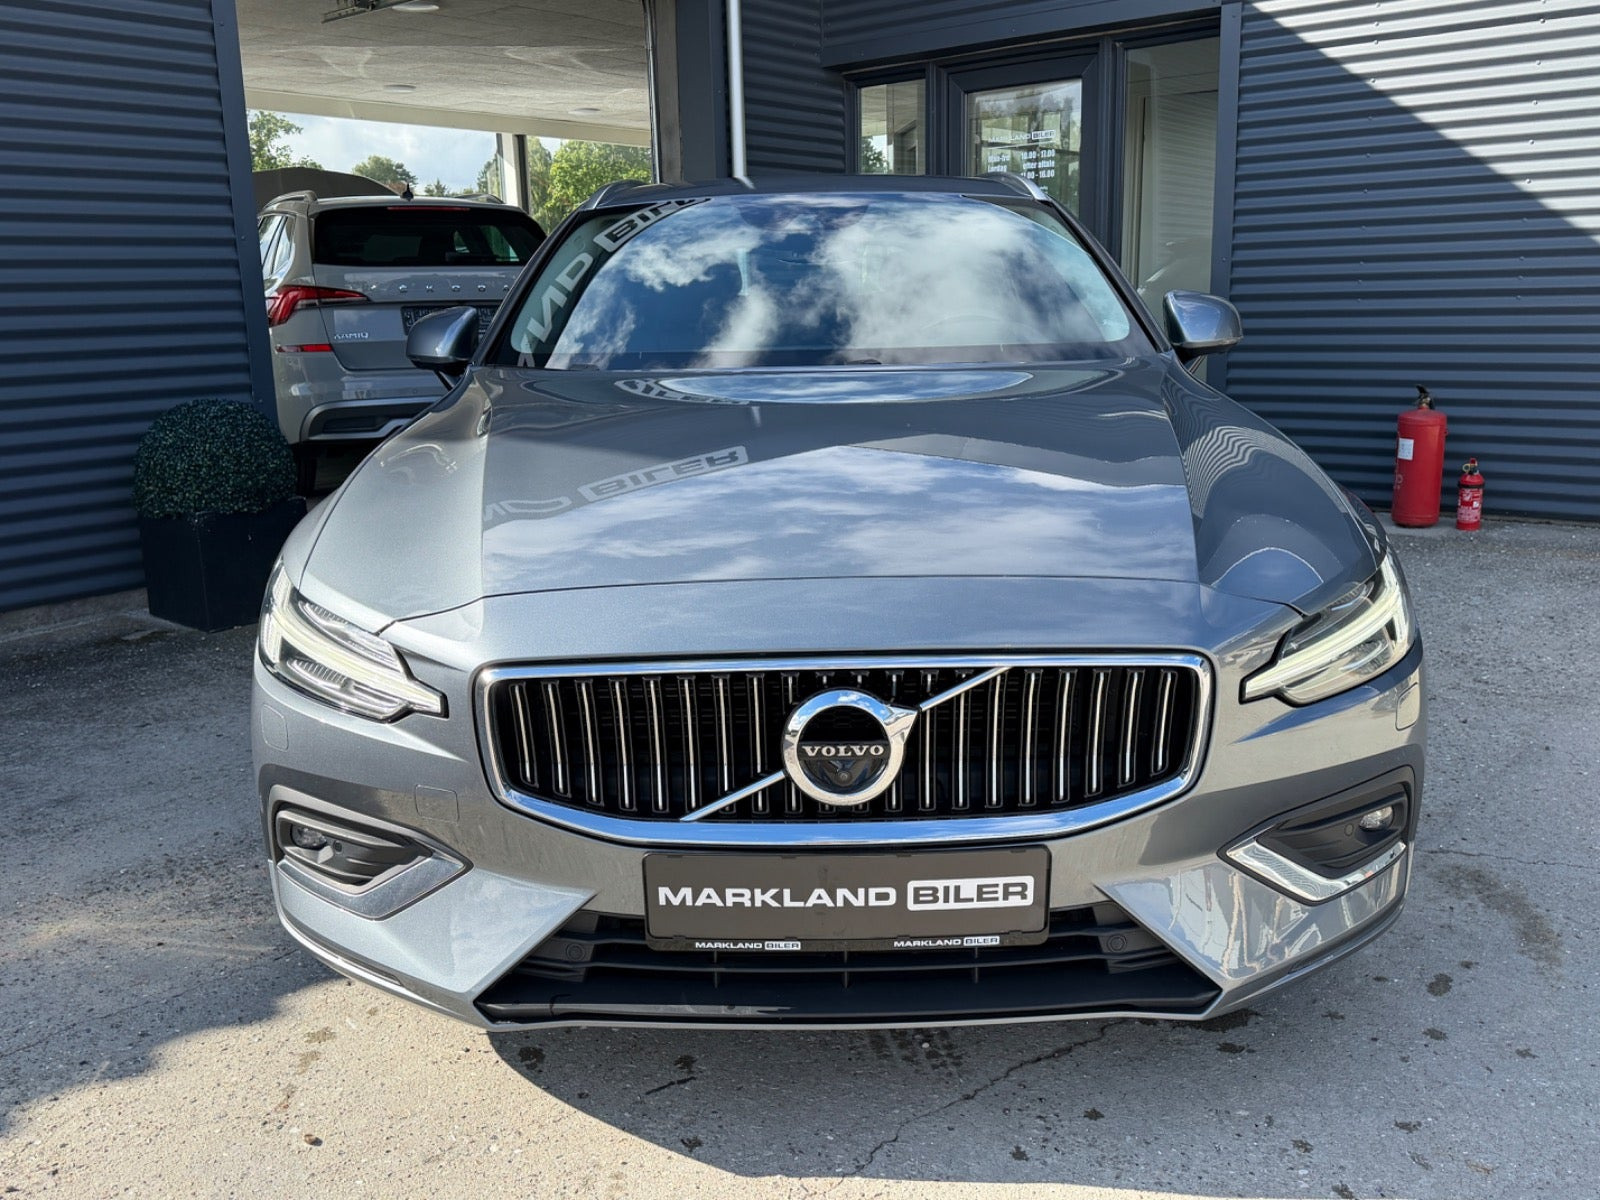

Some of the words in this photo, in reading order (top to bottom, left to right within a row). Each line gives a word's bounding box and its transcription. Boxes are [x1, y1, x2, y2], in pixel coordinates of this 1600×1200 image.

[802, 745, 885, 757] VOLVO
[657, 885, 898, 909] MARKLAND
[911, 880, 1031, 906] BILER
[695, 941, 763, 949] MARKLAND
[765, 942, 800, 950] BILER
[893, 939, 962, 948] MARKLAND
[964, 937, 999, 945] BILER
